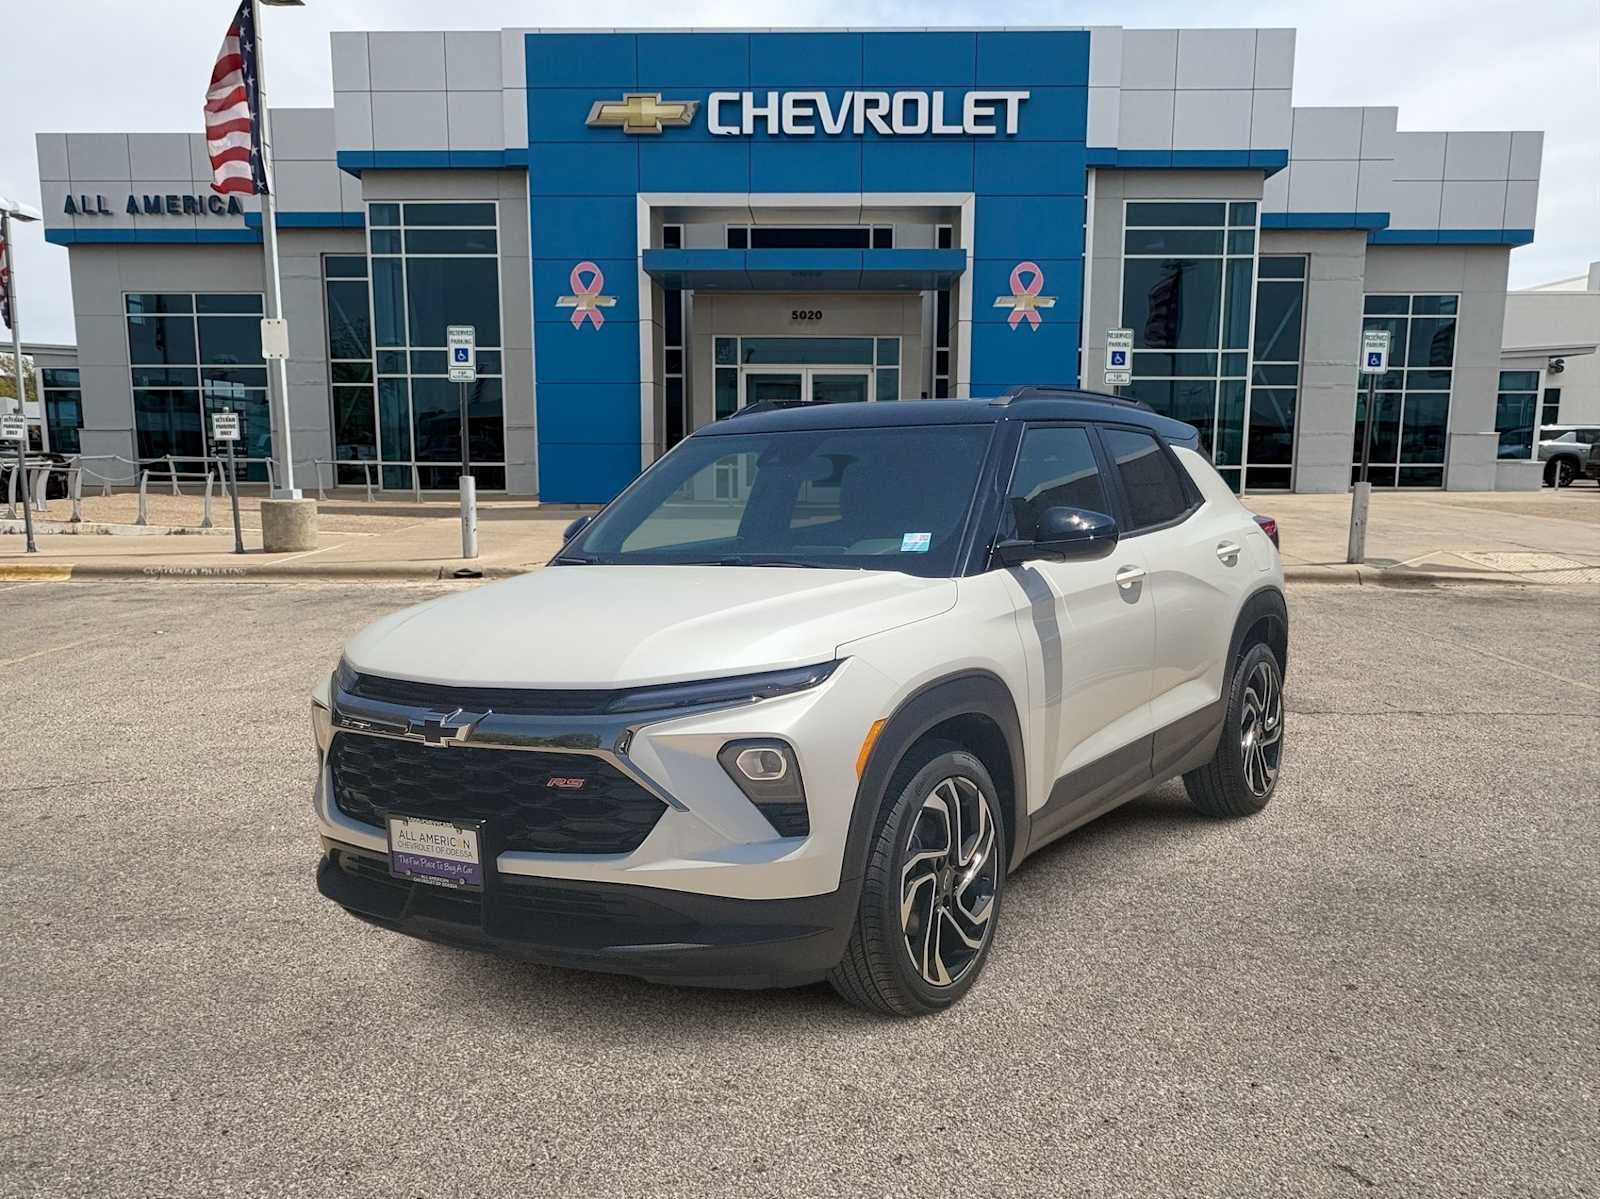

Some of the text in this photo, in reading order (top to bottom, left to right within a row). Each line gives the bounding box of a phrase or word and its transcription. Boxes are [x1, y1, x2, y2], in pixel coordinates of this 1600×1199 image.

[707, 90, 1031, 136] CHEVROLET
[64, 194, 112, 216] ALL
[791, 310, 823, 320] 5020
[546, 777, 585, 788] RS
[399, 829, 417, 842] ALL
[397, 840, 474, 859] CHEVROLET OF ODESSA
